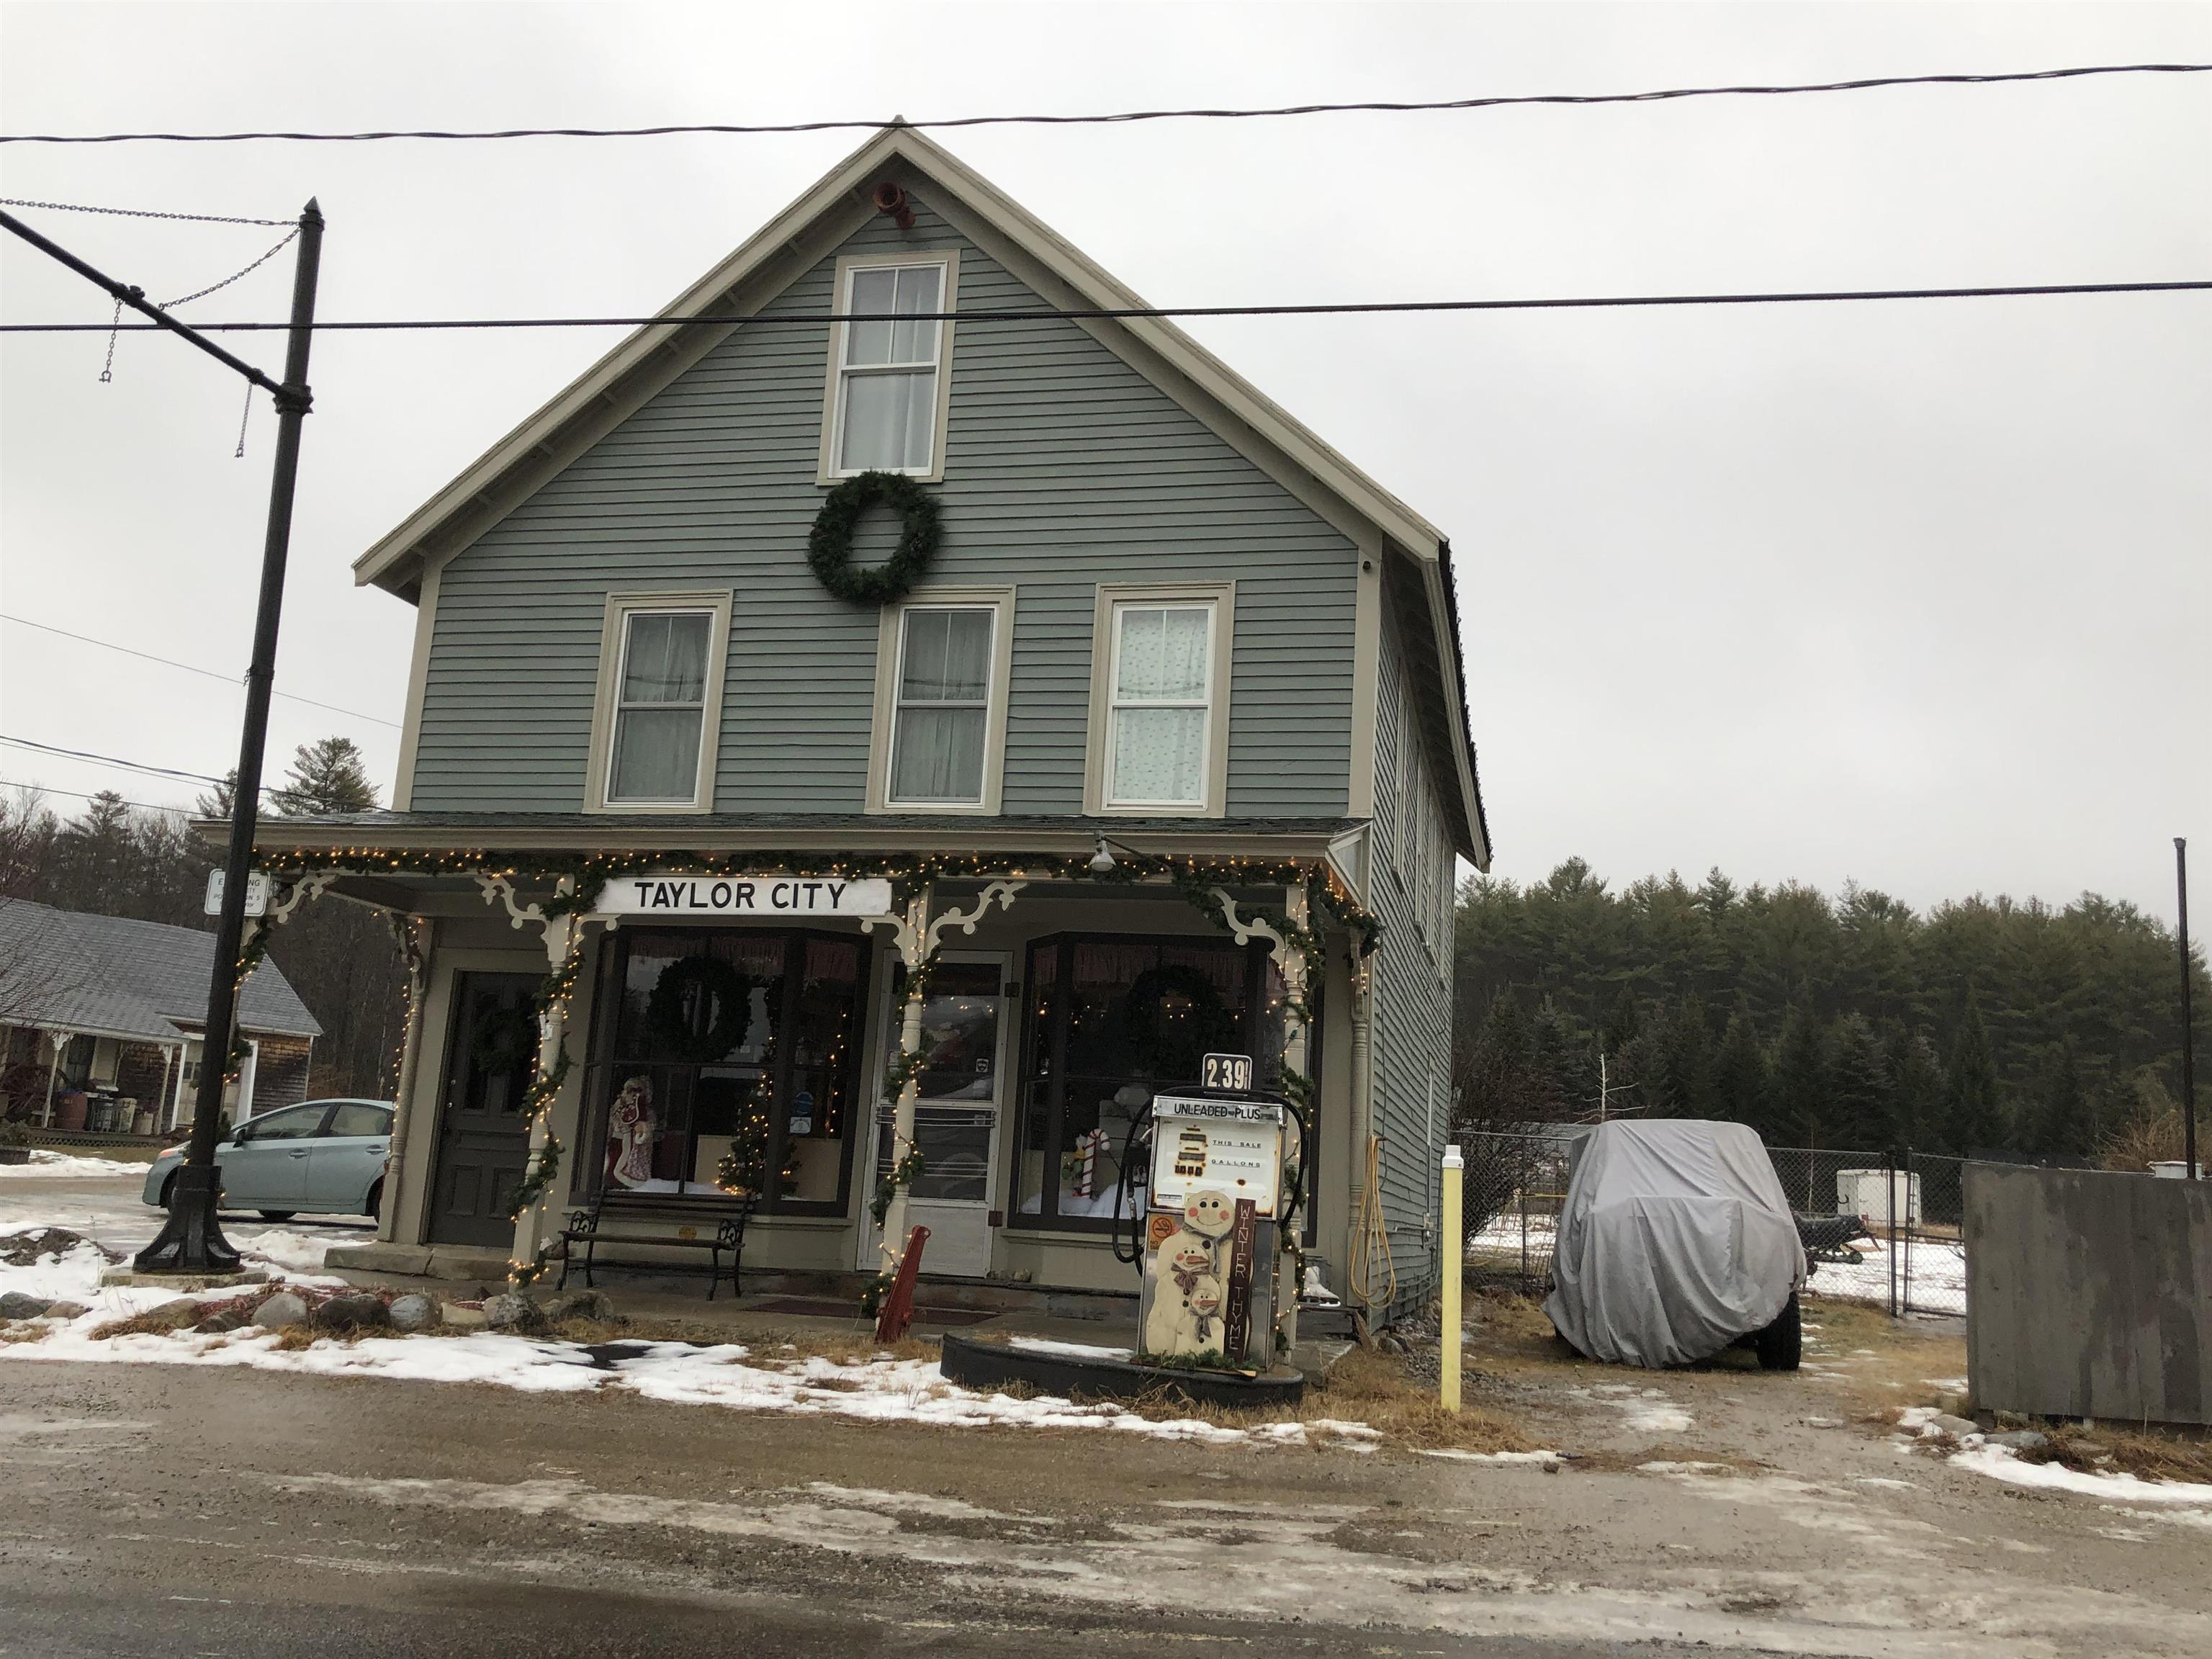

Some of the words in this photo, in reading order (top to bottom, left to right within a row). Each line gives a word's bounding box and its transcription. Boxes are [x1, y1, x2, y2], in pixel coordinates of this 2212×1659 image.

[634, 881, 755, 909] TAYLOR
[770, 882, 847, 909] CITY
[1174, 1103, 1228, 1117] UNLEADED
[1234, 1107, 1261, 1120] PLUS
[1211, 1159, 1261, 1168] GALLONS
[1235, 1205, 1251, 1279] WINTER
[1229, 1286, 1244, 1350] THYME
